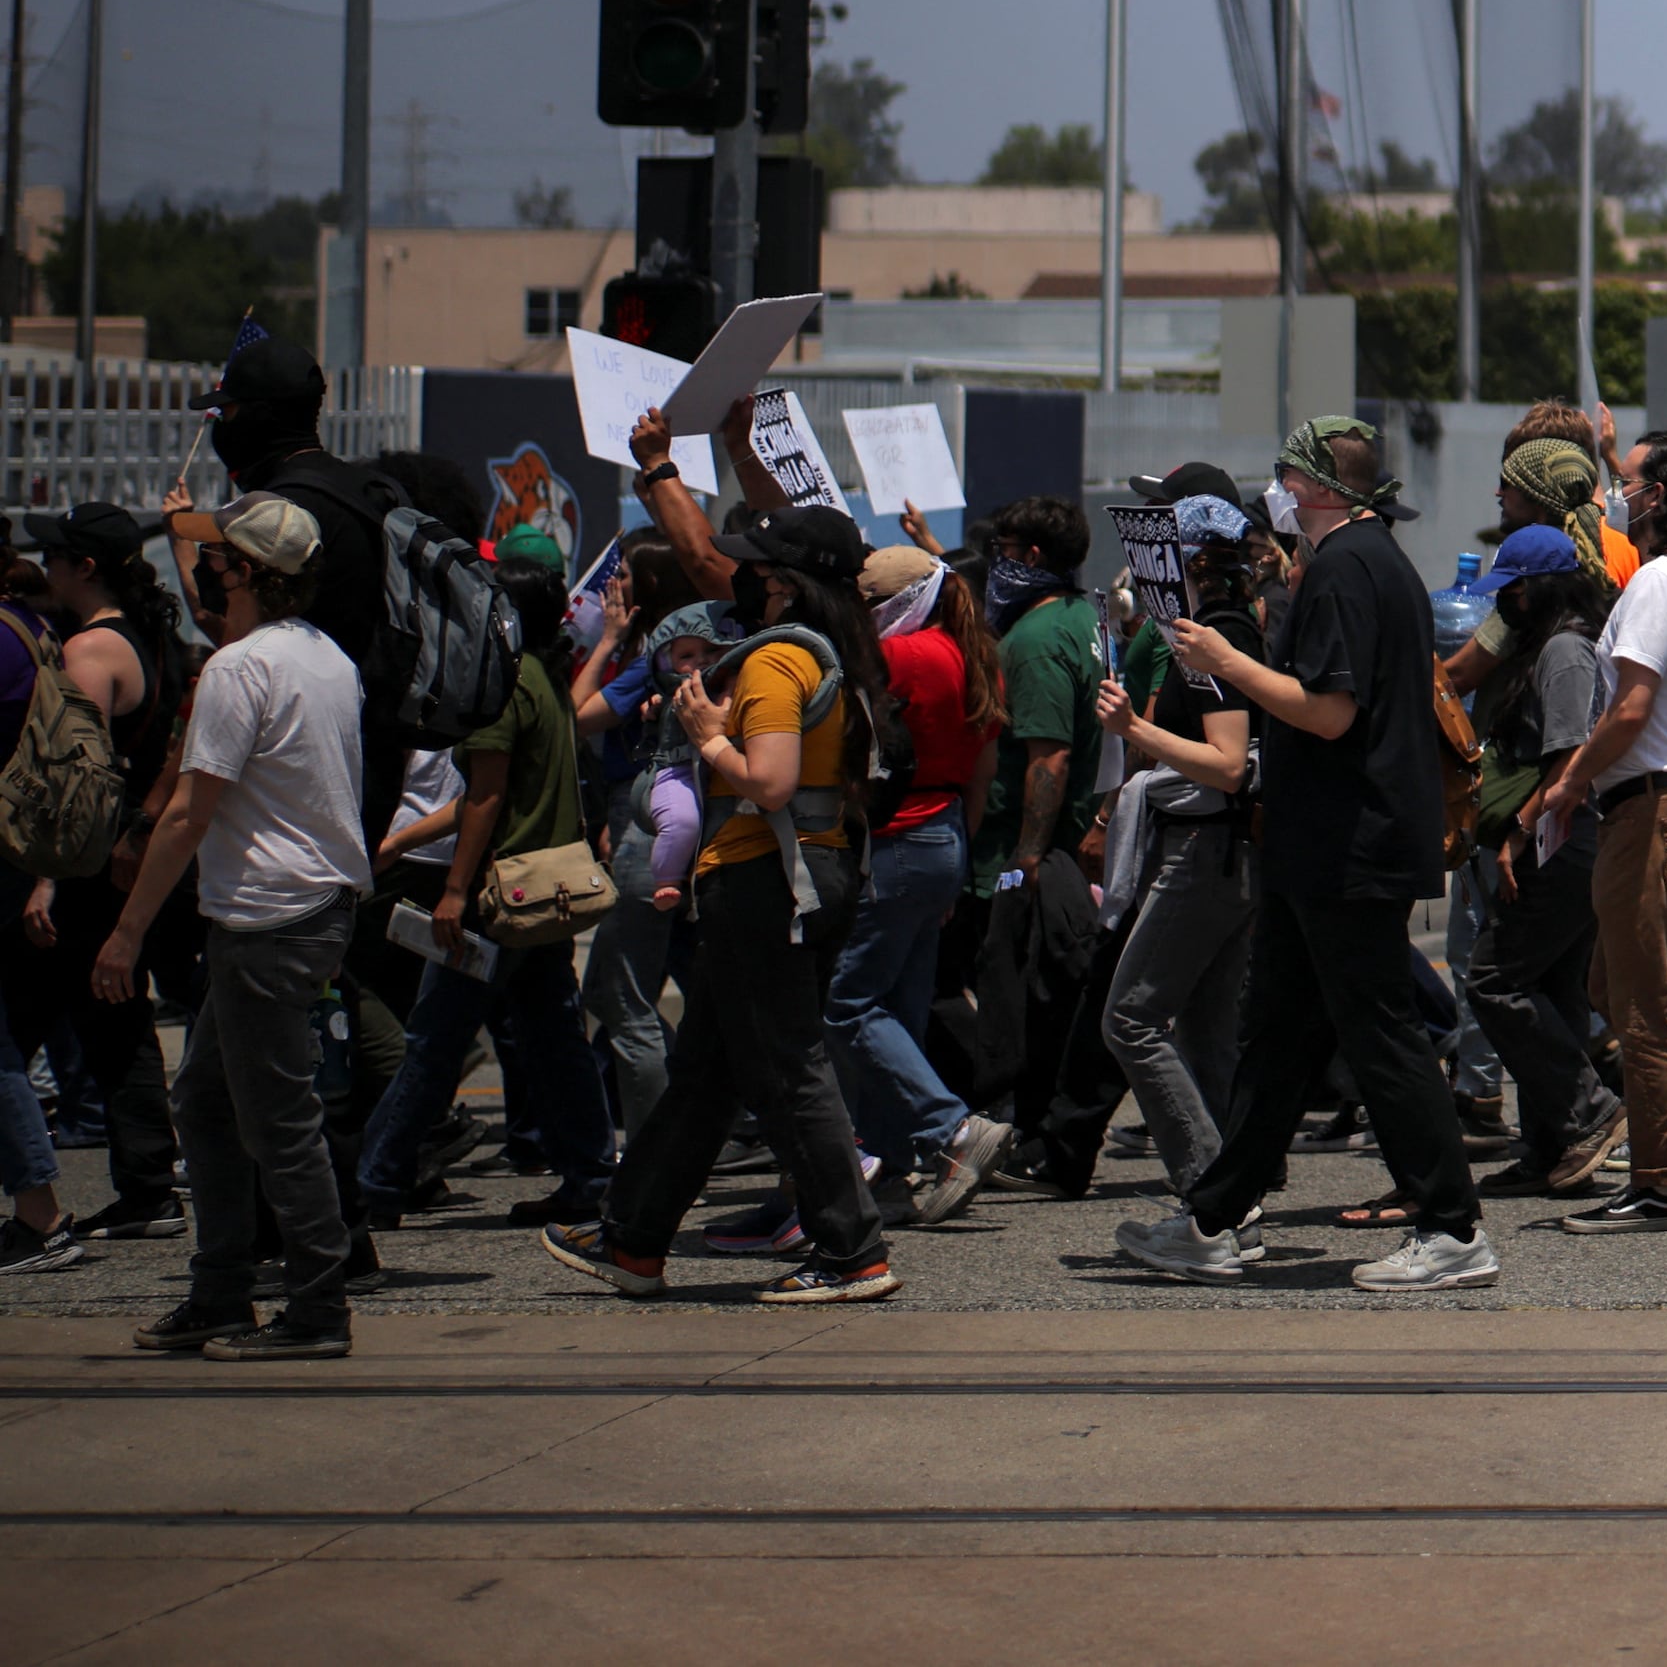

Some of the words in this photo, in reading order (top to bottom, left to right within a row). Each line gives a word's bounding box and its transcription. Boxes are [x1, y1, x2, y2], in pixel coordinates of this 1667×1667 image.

[594, 347, 623, 374] WE
[754, 436, 766, 453] NO
[1124, 539, 1181, 583] CHINGA
